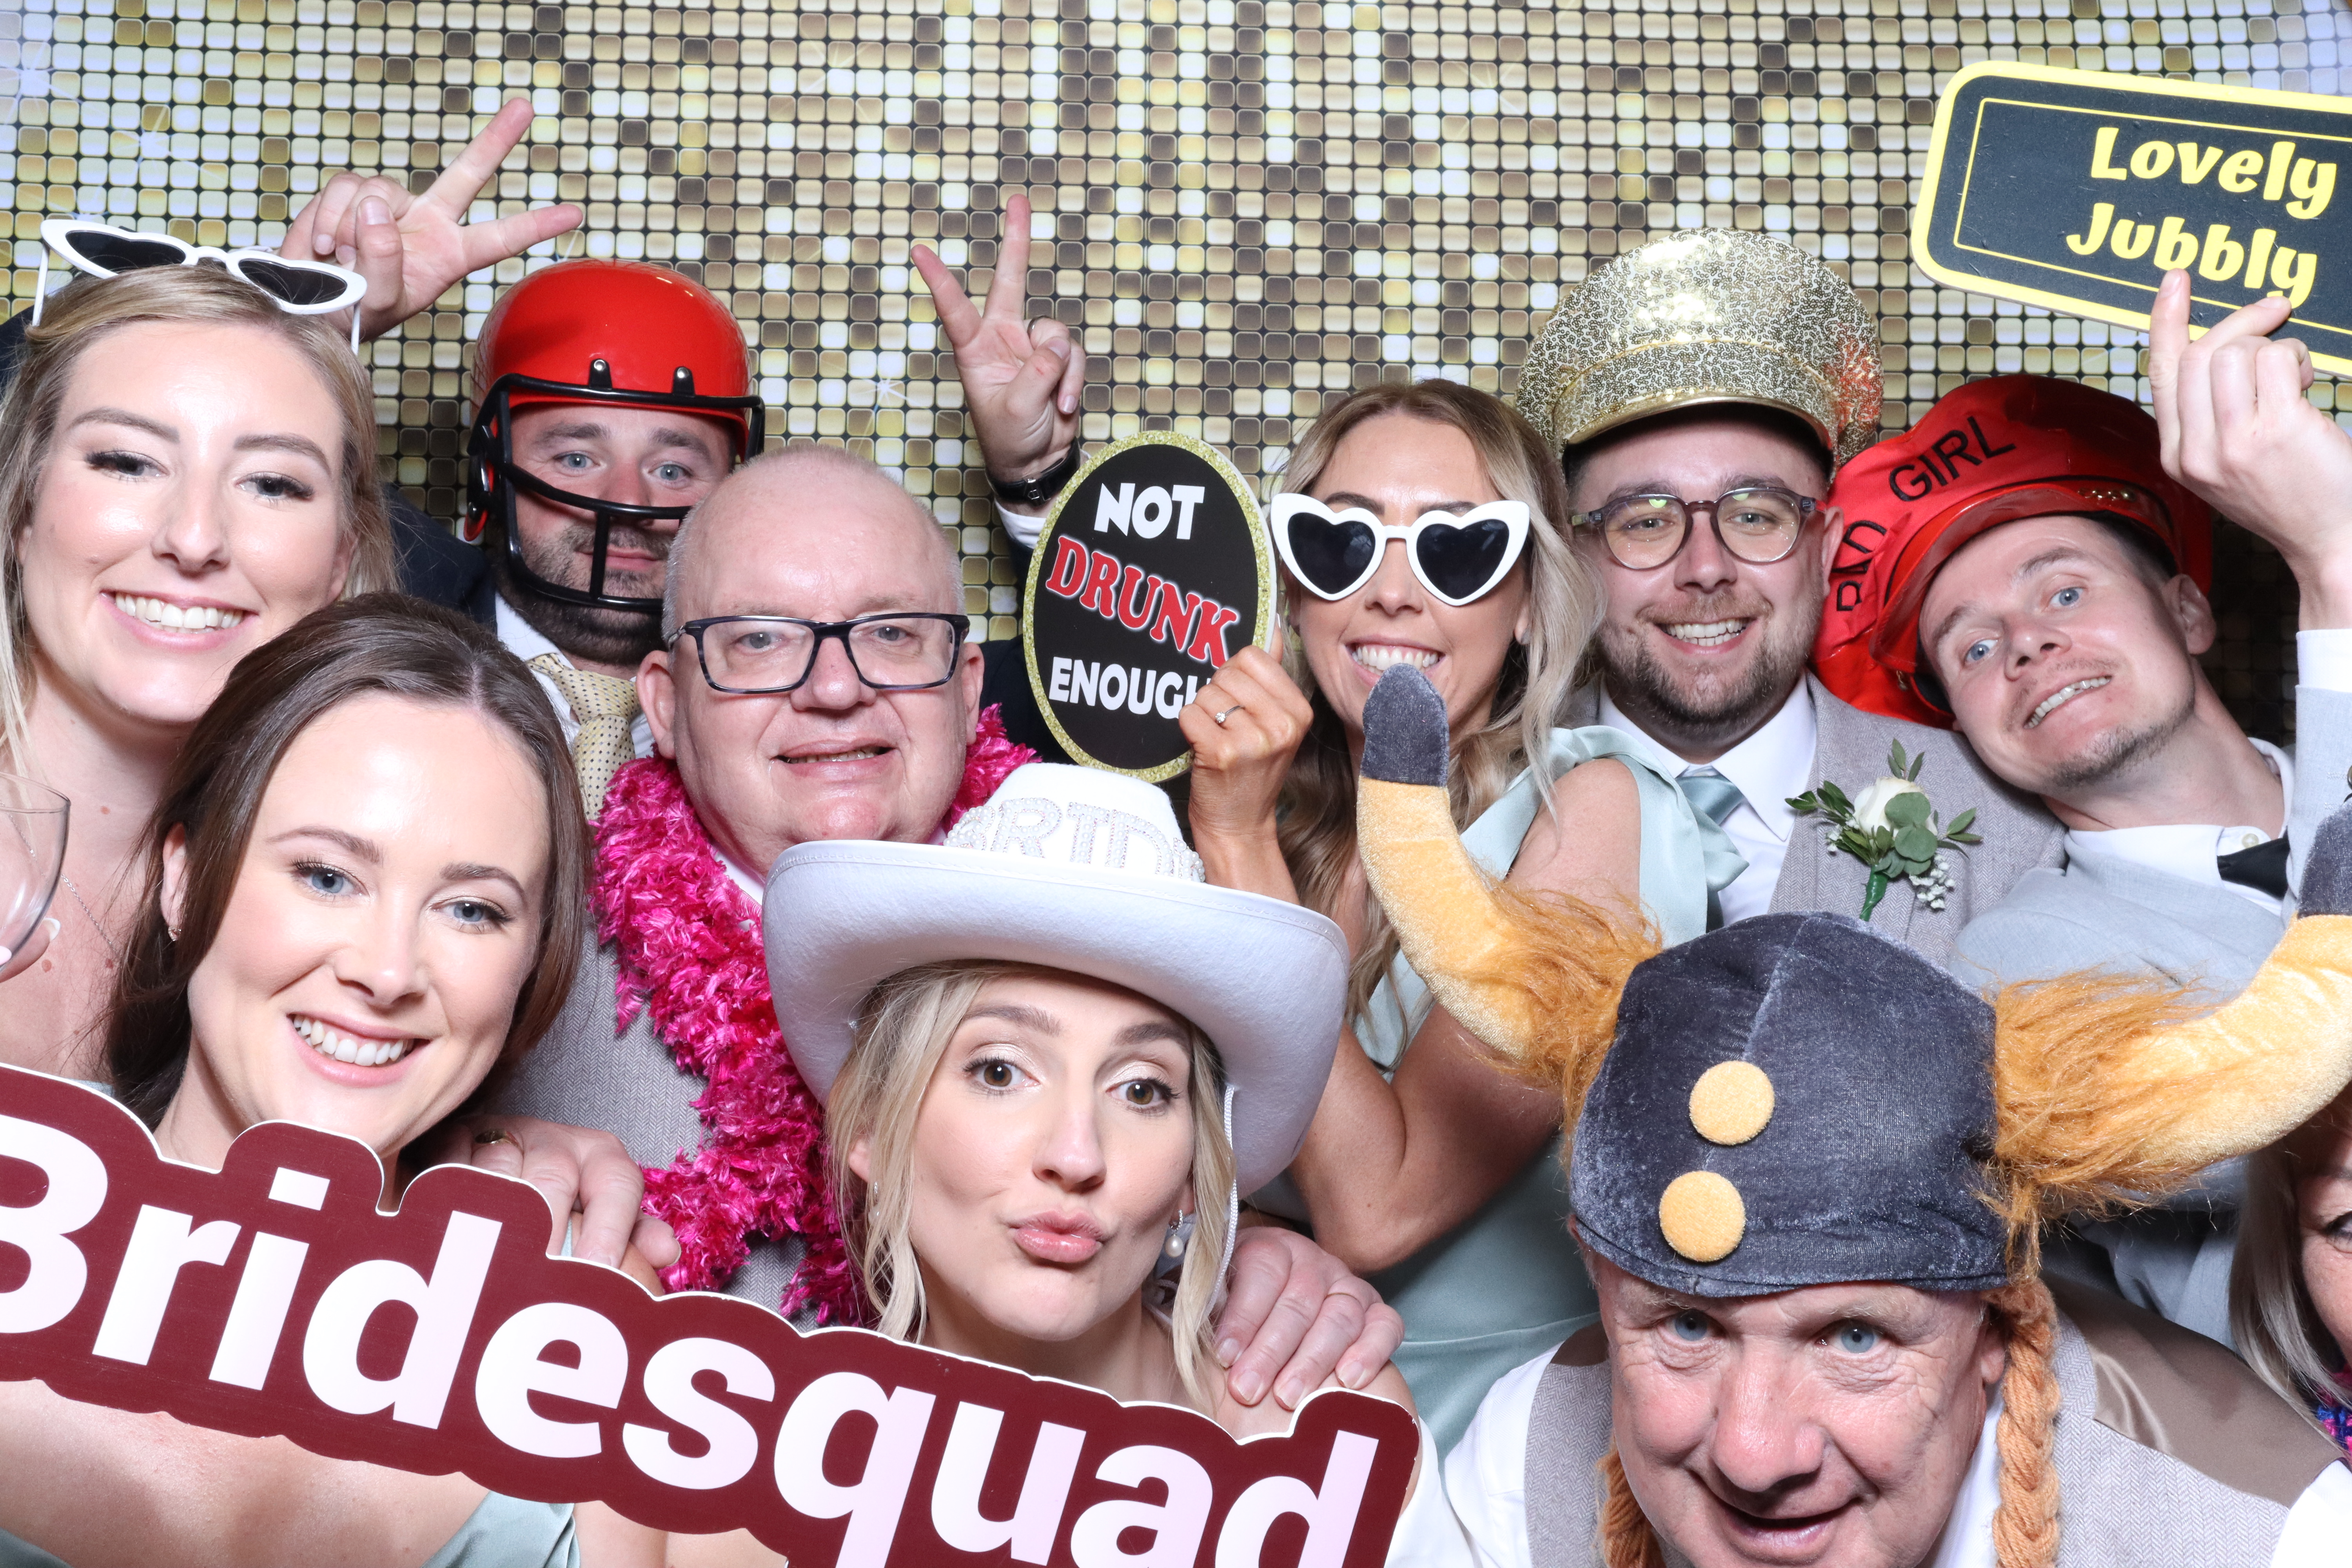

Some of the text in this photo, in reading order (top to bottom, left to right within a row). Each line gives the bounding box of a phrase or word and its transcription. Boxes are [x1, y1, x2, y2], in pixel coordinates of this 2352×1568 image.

[2091, 127, 2336, 219] Lovely
[2066, 203, 2317, 310] Jubbly
[1889, 416, 2016, 502] GIRL
[1094, 483, 1205, 540] NOT
[1045, 535, 1239, 669] DRUNK
[0, 1114, 1379, 1568] Bridesquad
